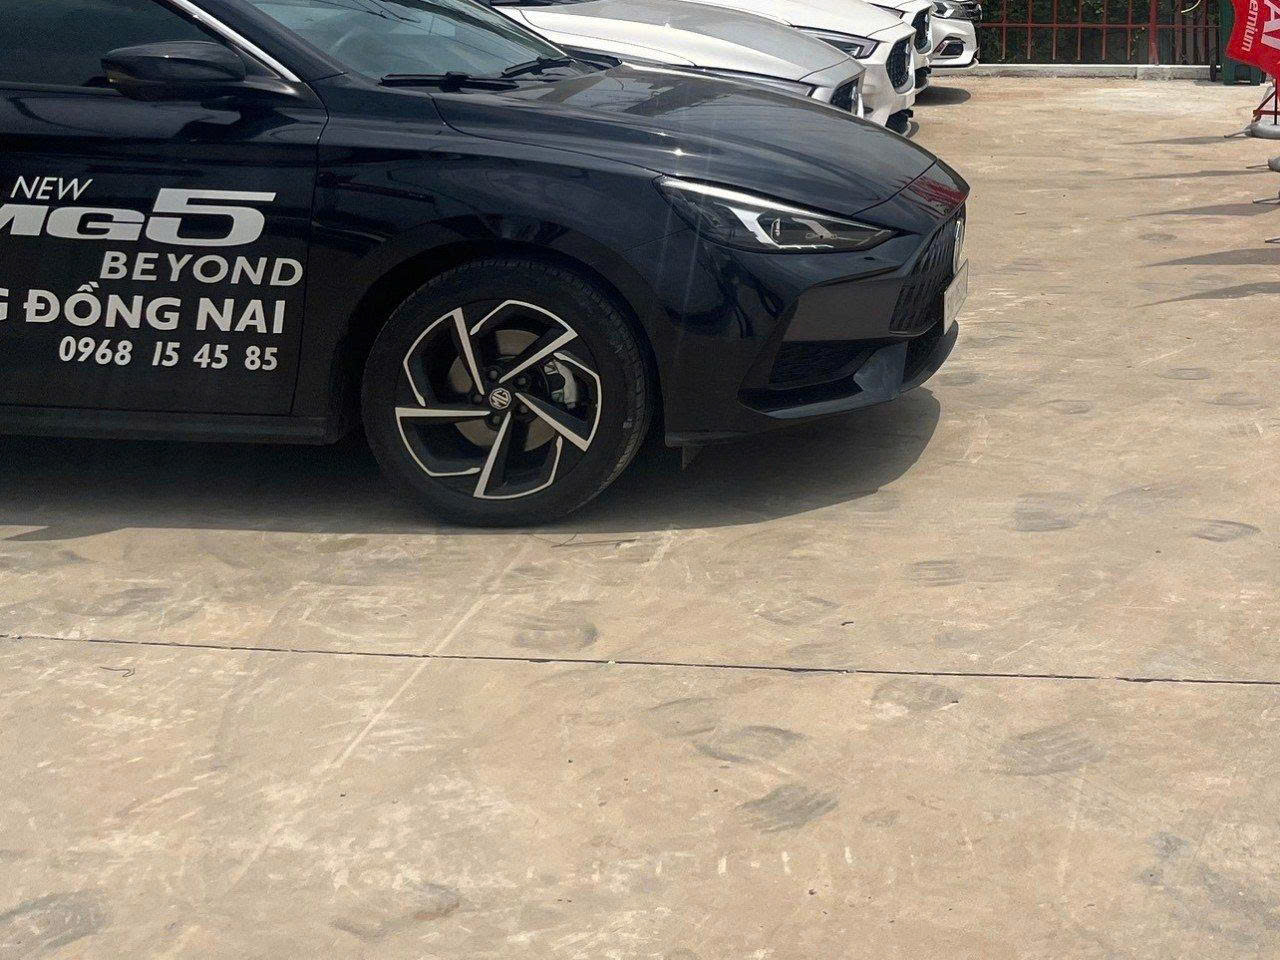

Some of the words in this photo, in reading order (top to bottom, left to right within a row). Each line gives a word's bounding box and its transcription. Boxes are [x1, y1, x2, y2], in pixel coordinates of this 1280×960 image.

[11, 176, 93, 200] NEW
[100, 251, 303, 287] BEYOND
[23, 281, 182, 331] ĐỒNG
[196, 298, 286, 334] NAI
[59, 336, 133, 365] 0968
[152, 341, 180, 367] 15
[193, 343, 229, 369] 45
[244, 346, 278, 371] 85
